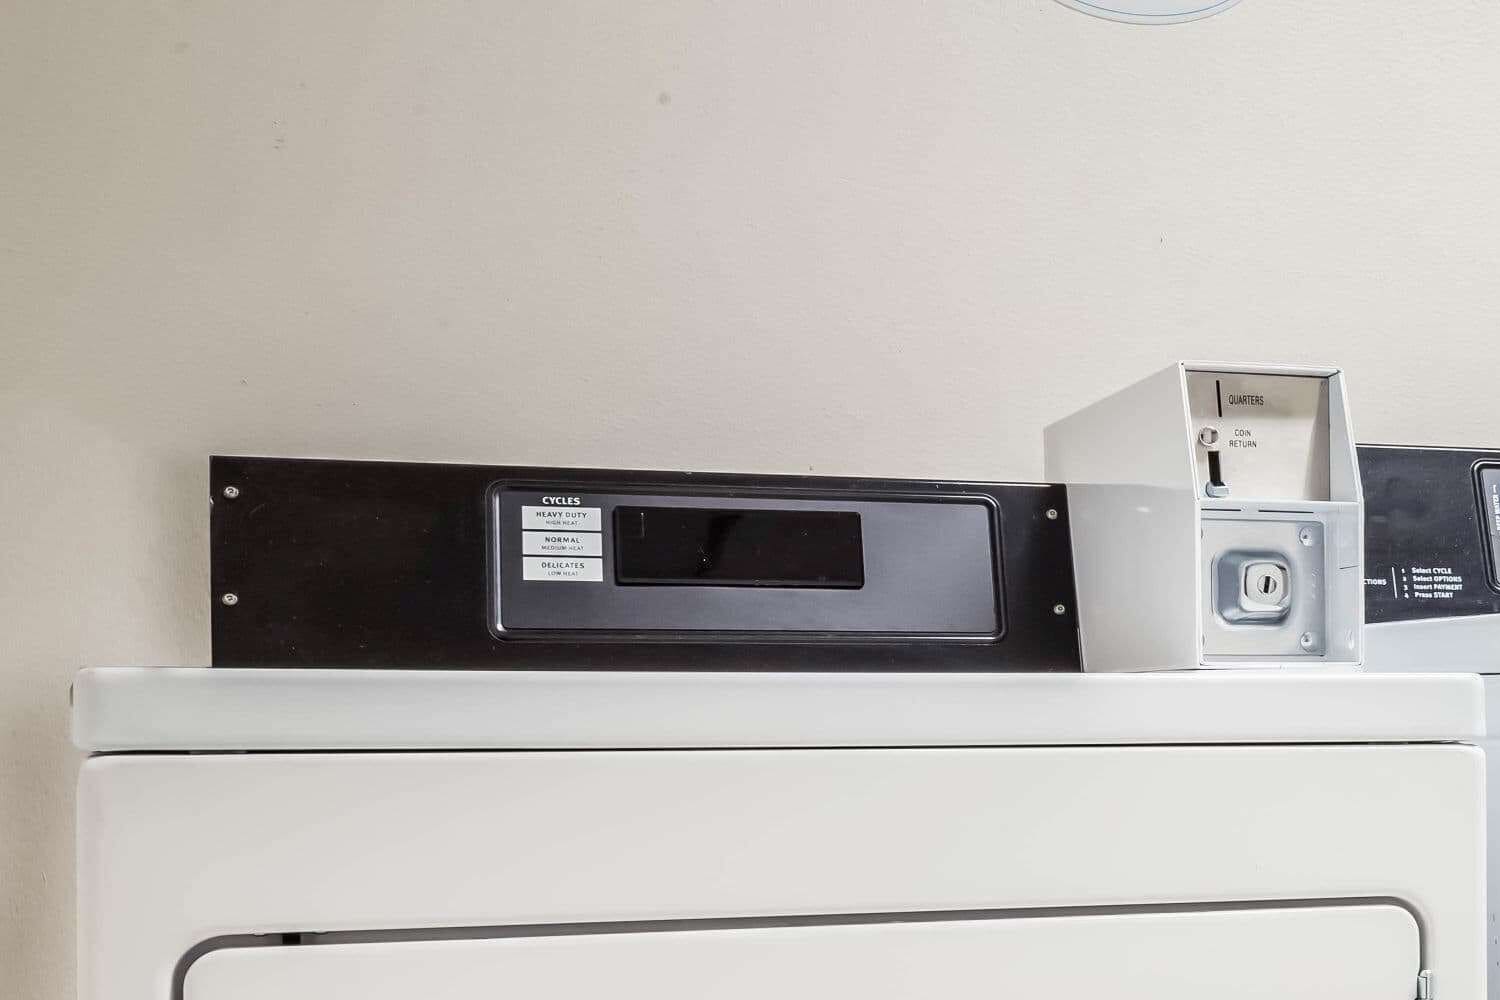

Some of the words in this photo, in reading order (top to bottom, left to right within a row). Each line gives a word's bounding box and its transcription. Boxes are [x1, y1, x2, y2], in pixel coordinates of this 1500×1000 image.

[1228, 394, 1264, 406] QUARTERS
[1234, 429, 1251, 437] COIN
[1229, 440, 1257, 448] RETURN
[542, 496, 581, 505] CYCLES
[544, 536, 581, 544] NORMAL
